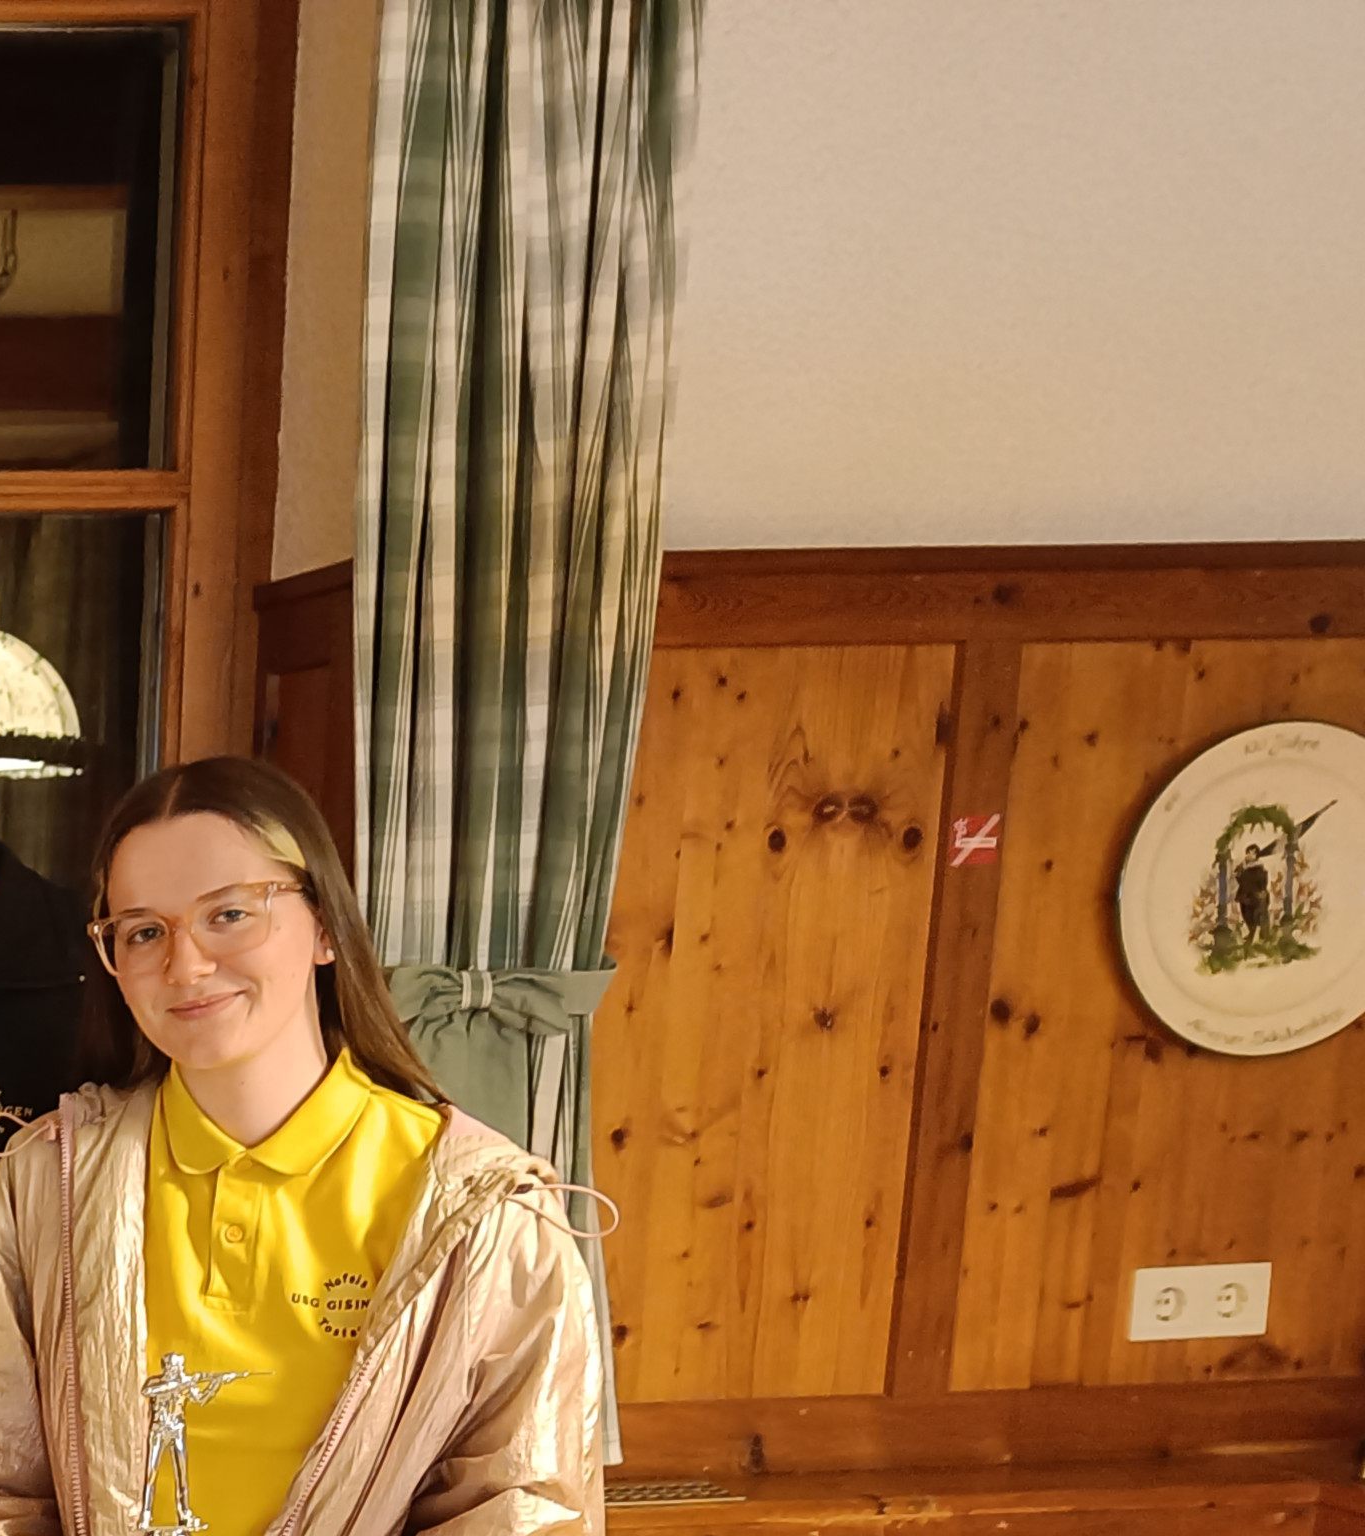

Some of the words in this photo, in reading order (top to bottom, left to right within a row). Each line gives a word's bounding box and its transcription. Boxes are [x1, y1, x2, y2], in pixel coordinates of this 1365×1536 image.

[291, 1293, 320, 1308] USG
[327, 1298, 371, 1310] GISIN
[319, 1317, 361, 1338] Toste
